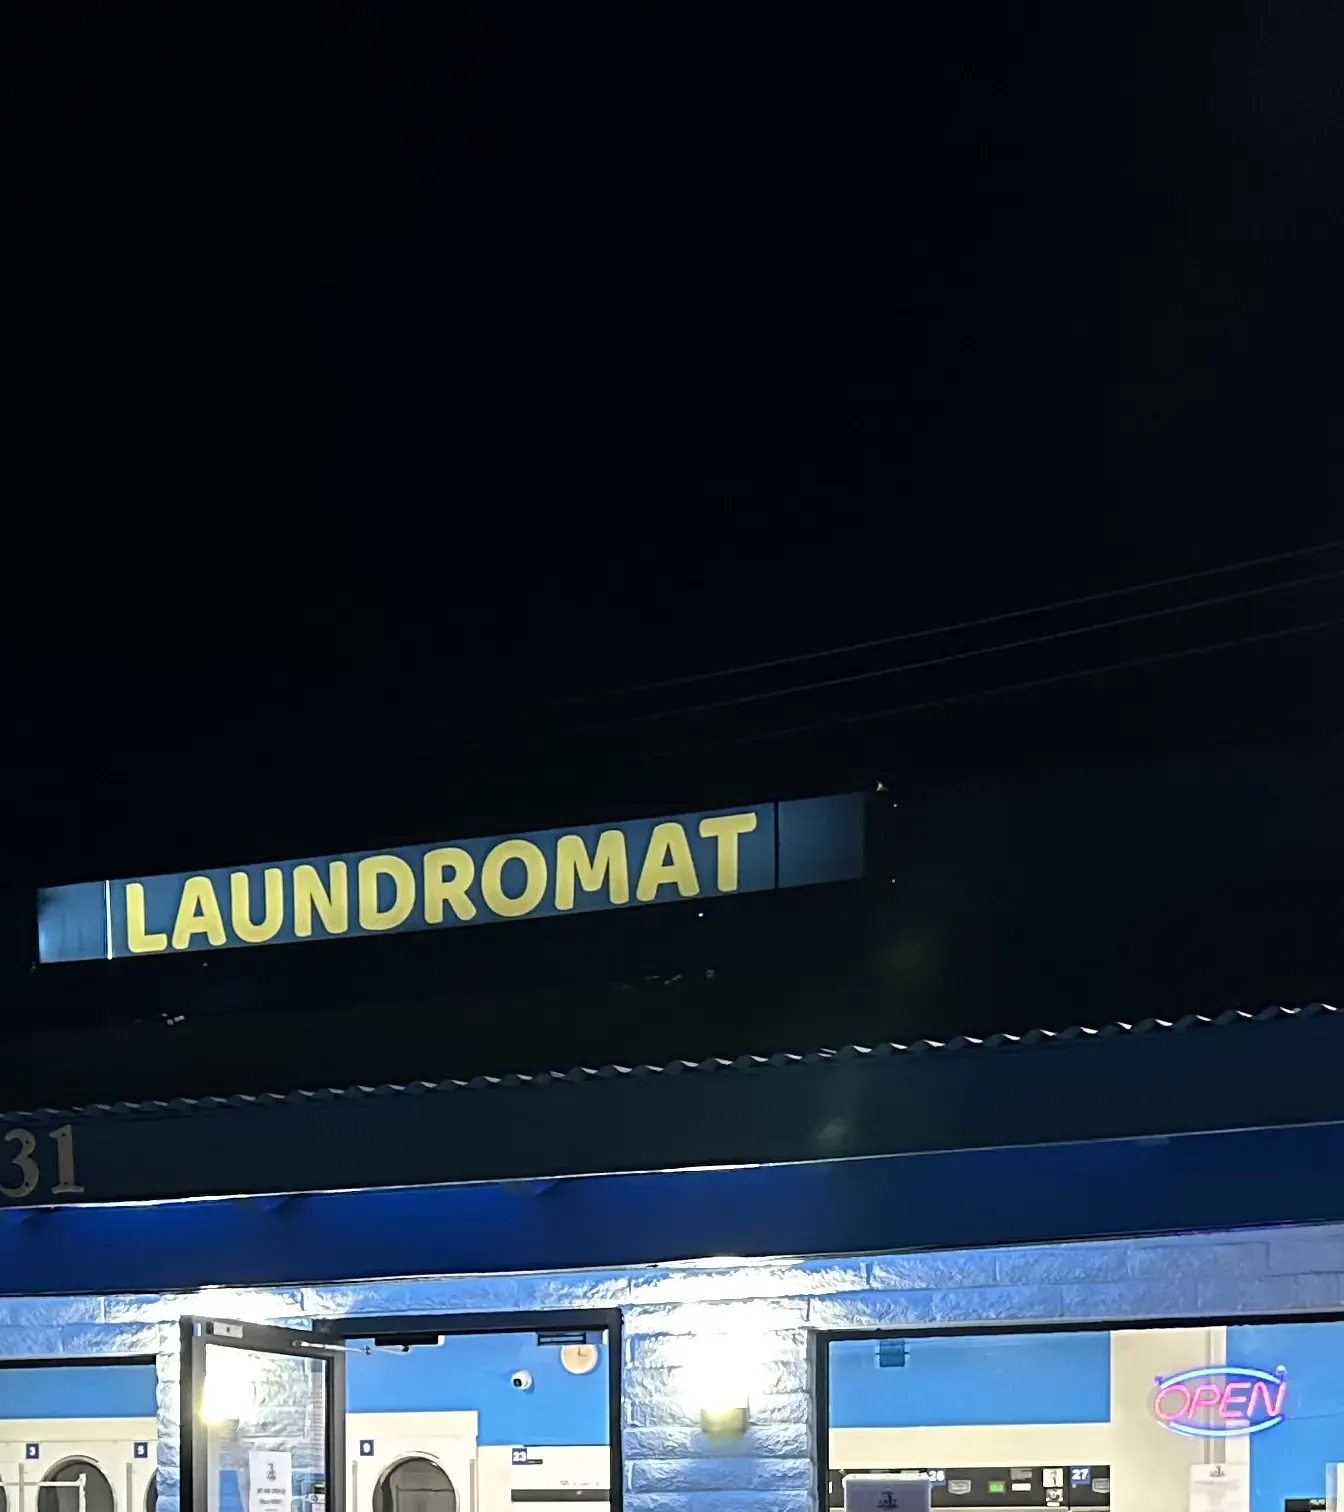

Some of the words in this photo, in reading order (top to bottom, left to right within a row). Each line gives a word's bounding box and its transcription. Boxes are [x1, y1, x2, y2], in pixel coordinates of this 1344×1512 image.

[123, 811, 759, 954] LAUNDROMAT
[1154, 1380, 1288, 1422] OPEN
[928, 1469, 946, 1482] 26
[1071, 1468, 1089, 1481] 27
